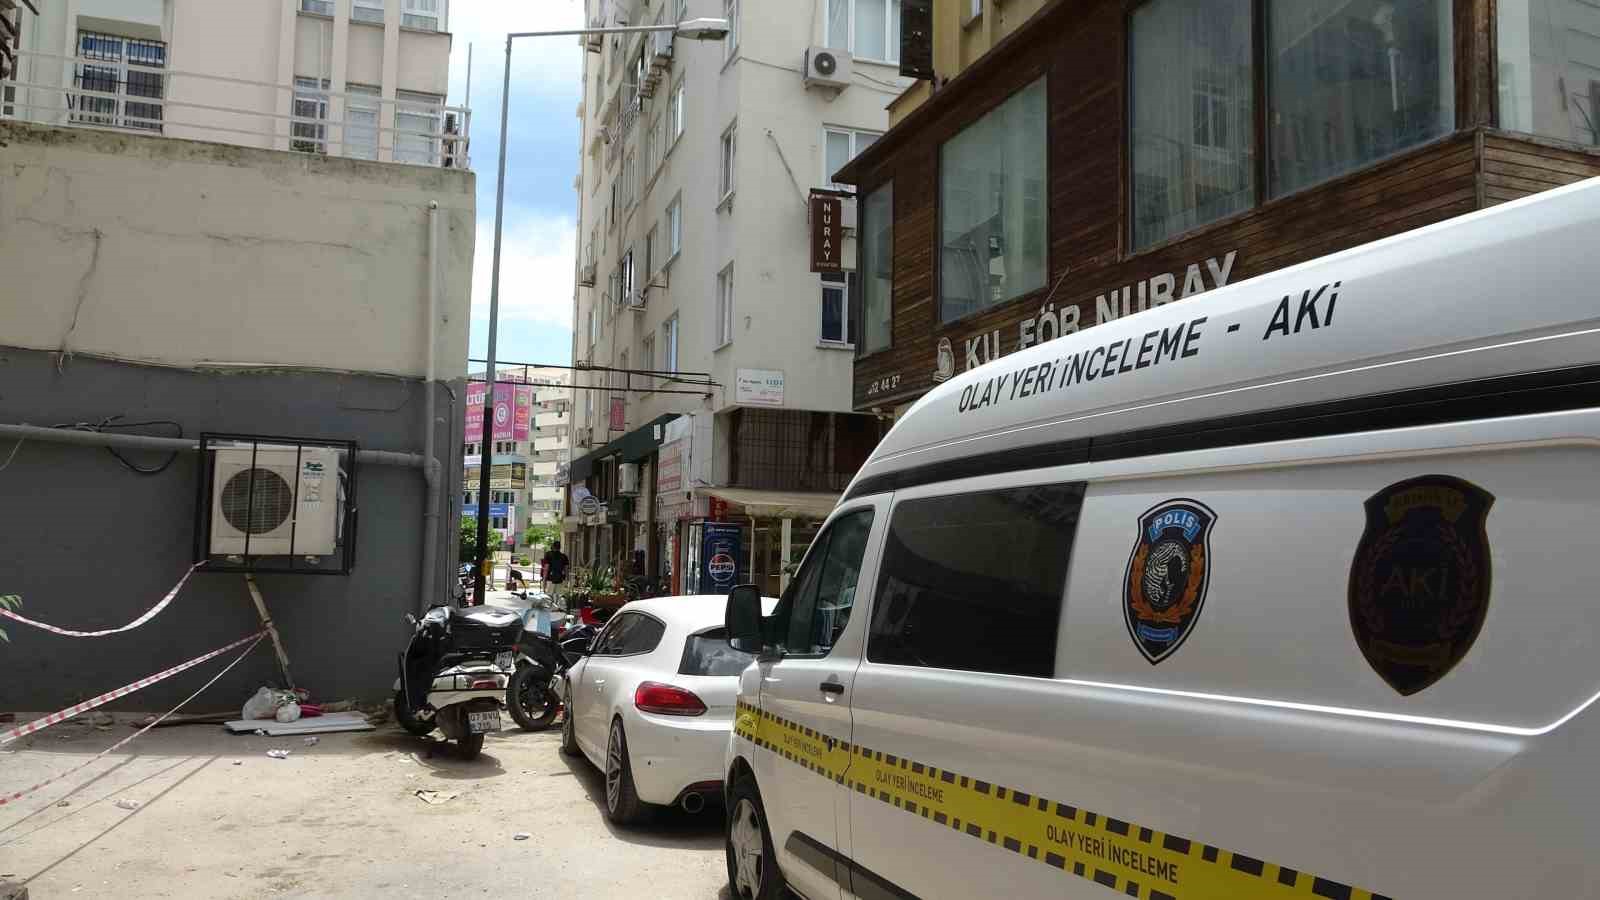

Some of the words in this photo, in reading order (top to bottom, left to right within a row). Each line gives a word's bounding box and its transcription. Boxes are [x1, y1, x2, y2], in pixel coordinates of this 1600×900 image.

[823, 202, 831, 261] NURAY
[965, 302, 1081, 370] KUFÖR
[1095, 250, 1237, 325] NURAY
[958, 374, 1008, 413] OLAY
[875, 769, 890, 784] OLAY
[1046, 825, 1075, 847] OLAY
